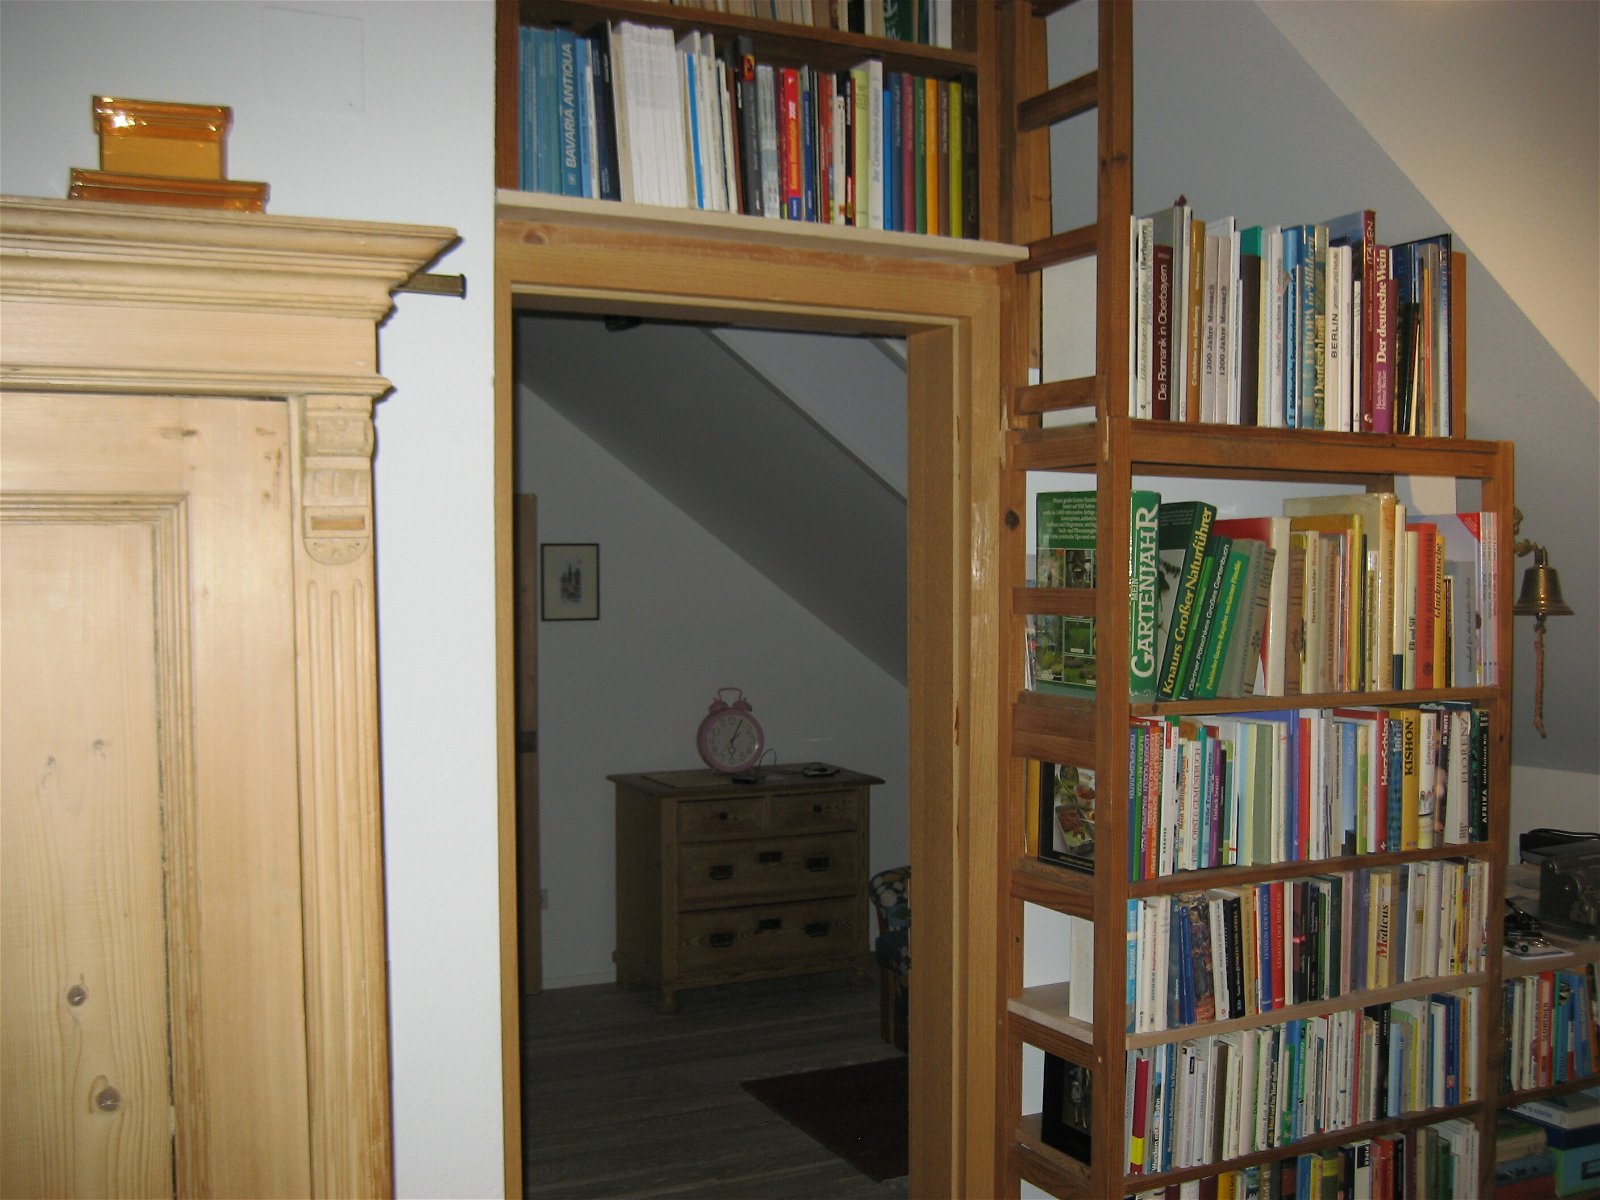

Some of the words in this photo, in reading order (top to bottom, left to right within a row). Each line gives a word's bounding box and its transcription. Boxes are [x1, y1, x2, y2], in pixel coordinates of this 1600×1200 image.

[561, 43, 575, 107] ANTIQUA
[563, 109, 577, 168] BAVARIA
[1366, 220, 1375, 265] ITALIEN
[1375, 248, 1387, 281] Wein
[1158, 263, 1169, 322] Oberbayern
[1207, 284, 1215, 323] Moosach
[1219, 286, 1228, 324] Moosach
[1375, 279, 1387, 338] deutsche
[1158, 338, 1168, 382] Romanik
[1206, 326, 1214, 350] Jahre
[1219, 326, 1227, 352] Jahre
[1303, 307, 1315, 365] EUROPA
[1314, 314, 1325, 397] Deutschland
[1331, 312, 1339, 358] BERLIN
[1376, 338, 1387, 362] Der
[1219, 354, 1227, 377] 1200
[1185, 506, 1213, 590] Naturführer
[1131, 577, 1139, 602] MEIN
[1131, 504, 1159, 678] GARTENJAHR
[1175, 590, 1196, 642] Großer
[1188, 660, 1202, 691] Gärtner
[1204, 589, 1219, 619] Großes
[1212, 544, 1230, 589] Gartenbuch
[1161, 643, 1183, 694] Knaurs
[1408, 641, 1416, 651] ER
[1404, 721, 1414, 776] KISHON
[1460, 716, 1469, 783] FLORENZ
[1375, 904, 1391, 959] Medicus
